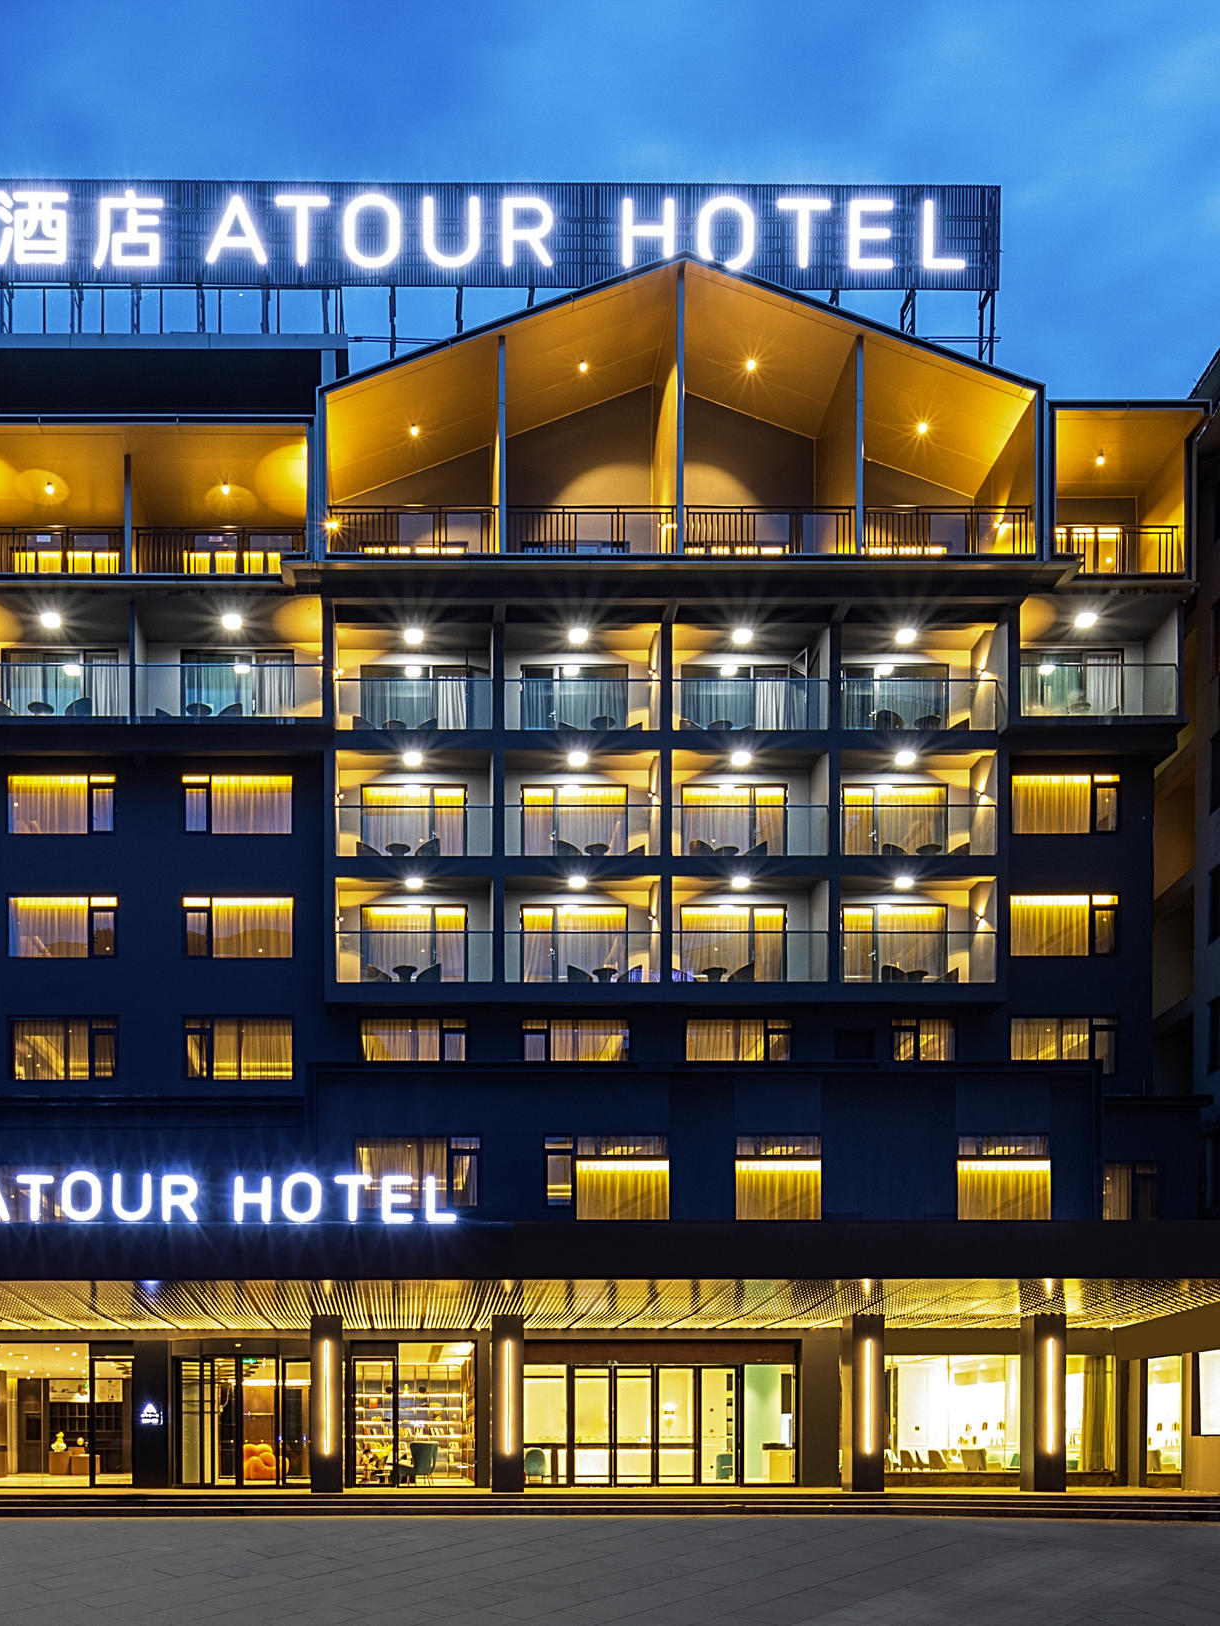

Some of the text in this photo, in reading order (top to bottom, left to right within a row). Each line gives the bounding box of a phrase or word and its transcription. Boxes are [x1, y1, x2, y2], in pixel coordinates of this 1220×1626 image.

[204, 191, 968, 273] ATOUR HOTEL
[232, 1170, 459, 1226] HOTEL
